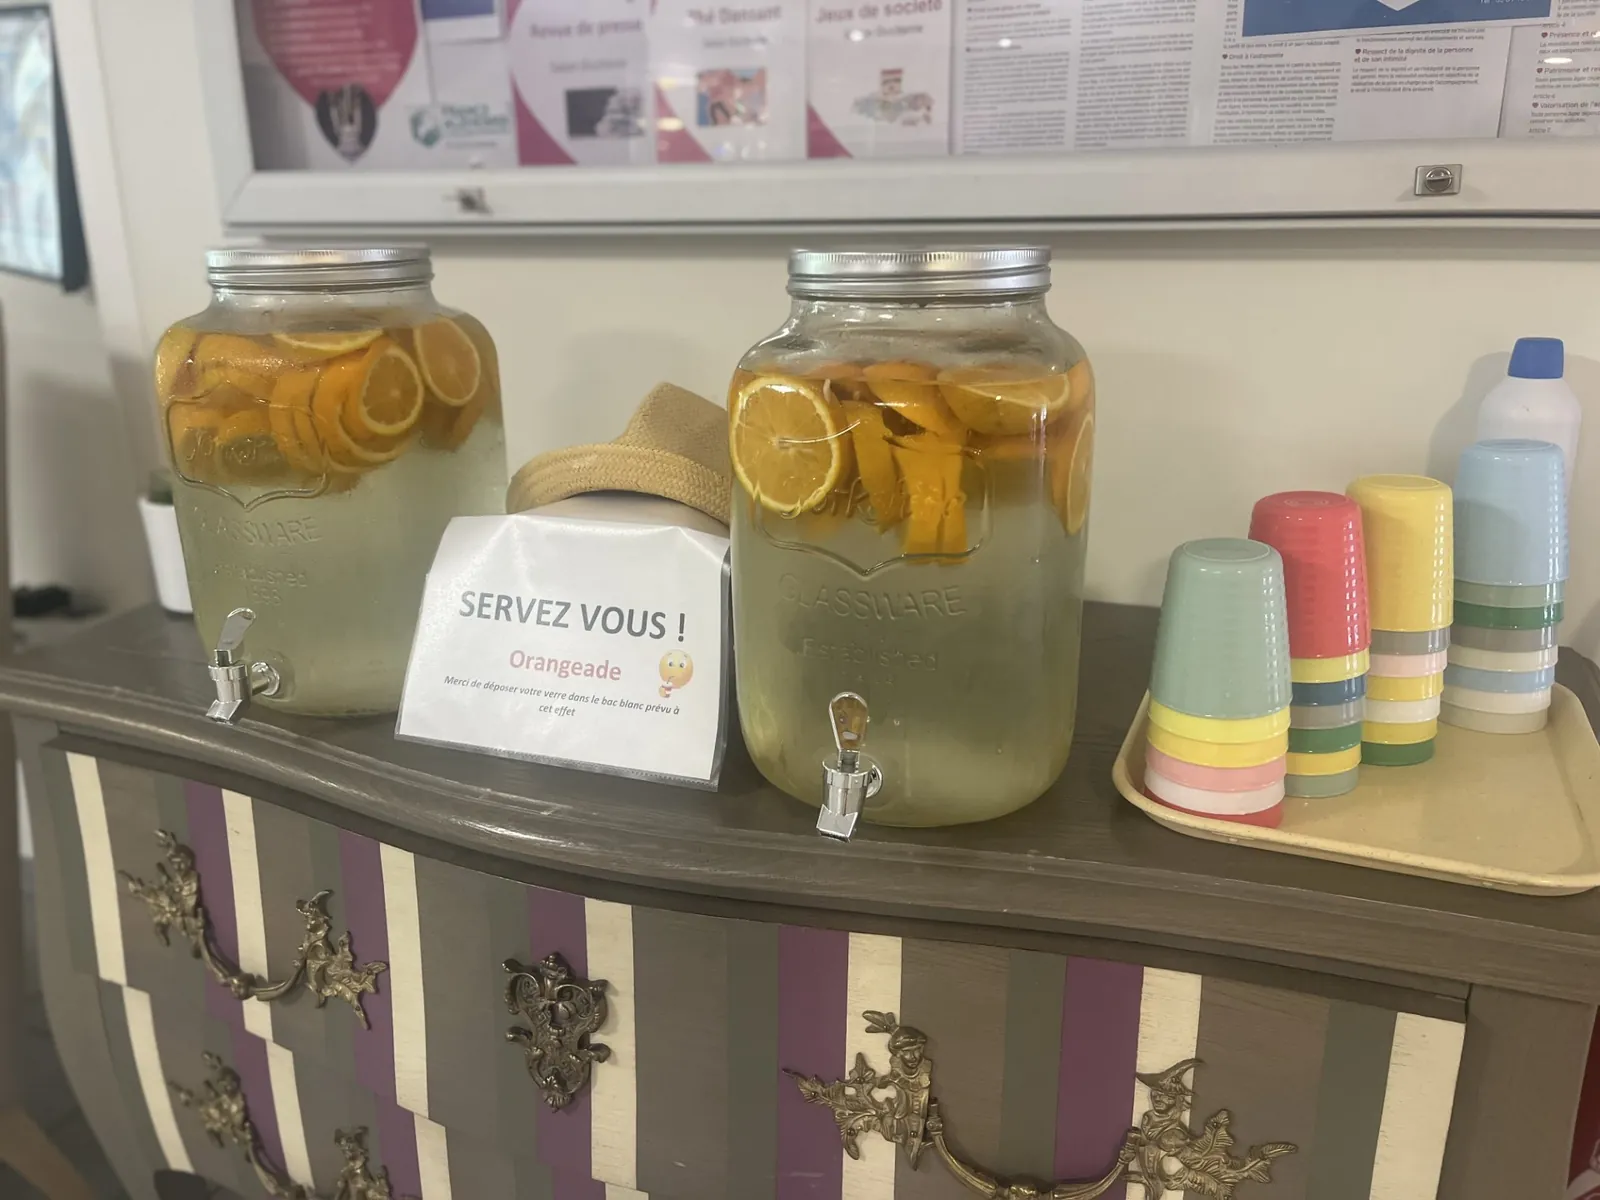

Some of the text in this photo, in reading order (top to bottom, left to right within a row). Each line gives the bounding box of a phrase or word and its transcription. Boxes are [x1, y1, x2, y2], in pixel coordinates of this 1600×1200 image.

[858, 4, 879, 19] de
[198, 513, 323, 547] ASSWARE
[778, 573, 968, 621] GLASSWARE
[458, 590, 686, 643] SERVEZ VOUS !
[509, 650, 622, 681] Orangeade
[444, 676, 680, 715] Merci de déposer votre verre dans le bac blanc prévu à
[538, 704, 576, 717] cet effet
